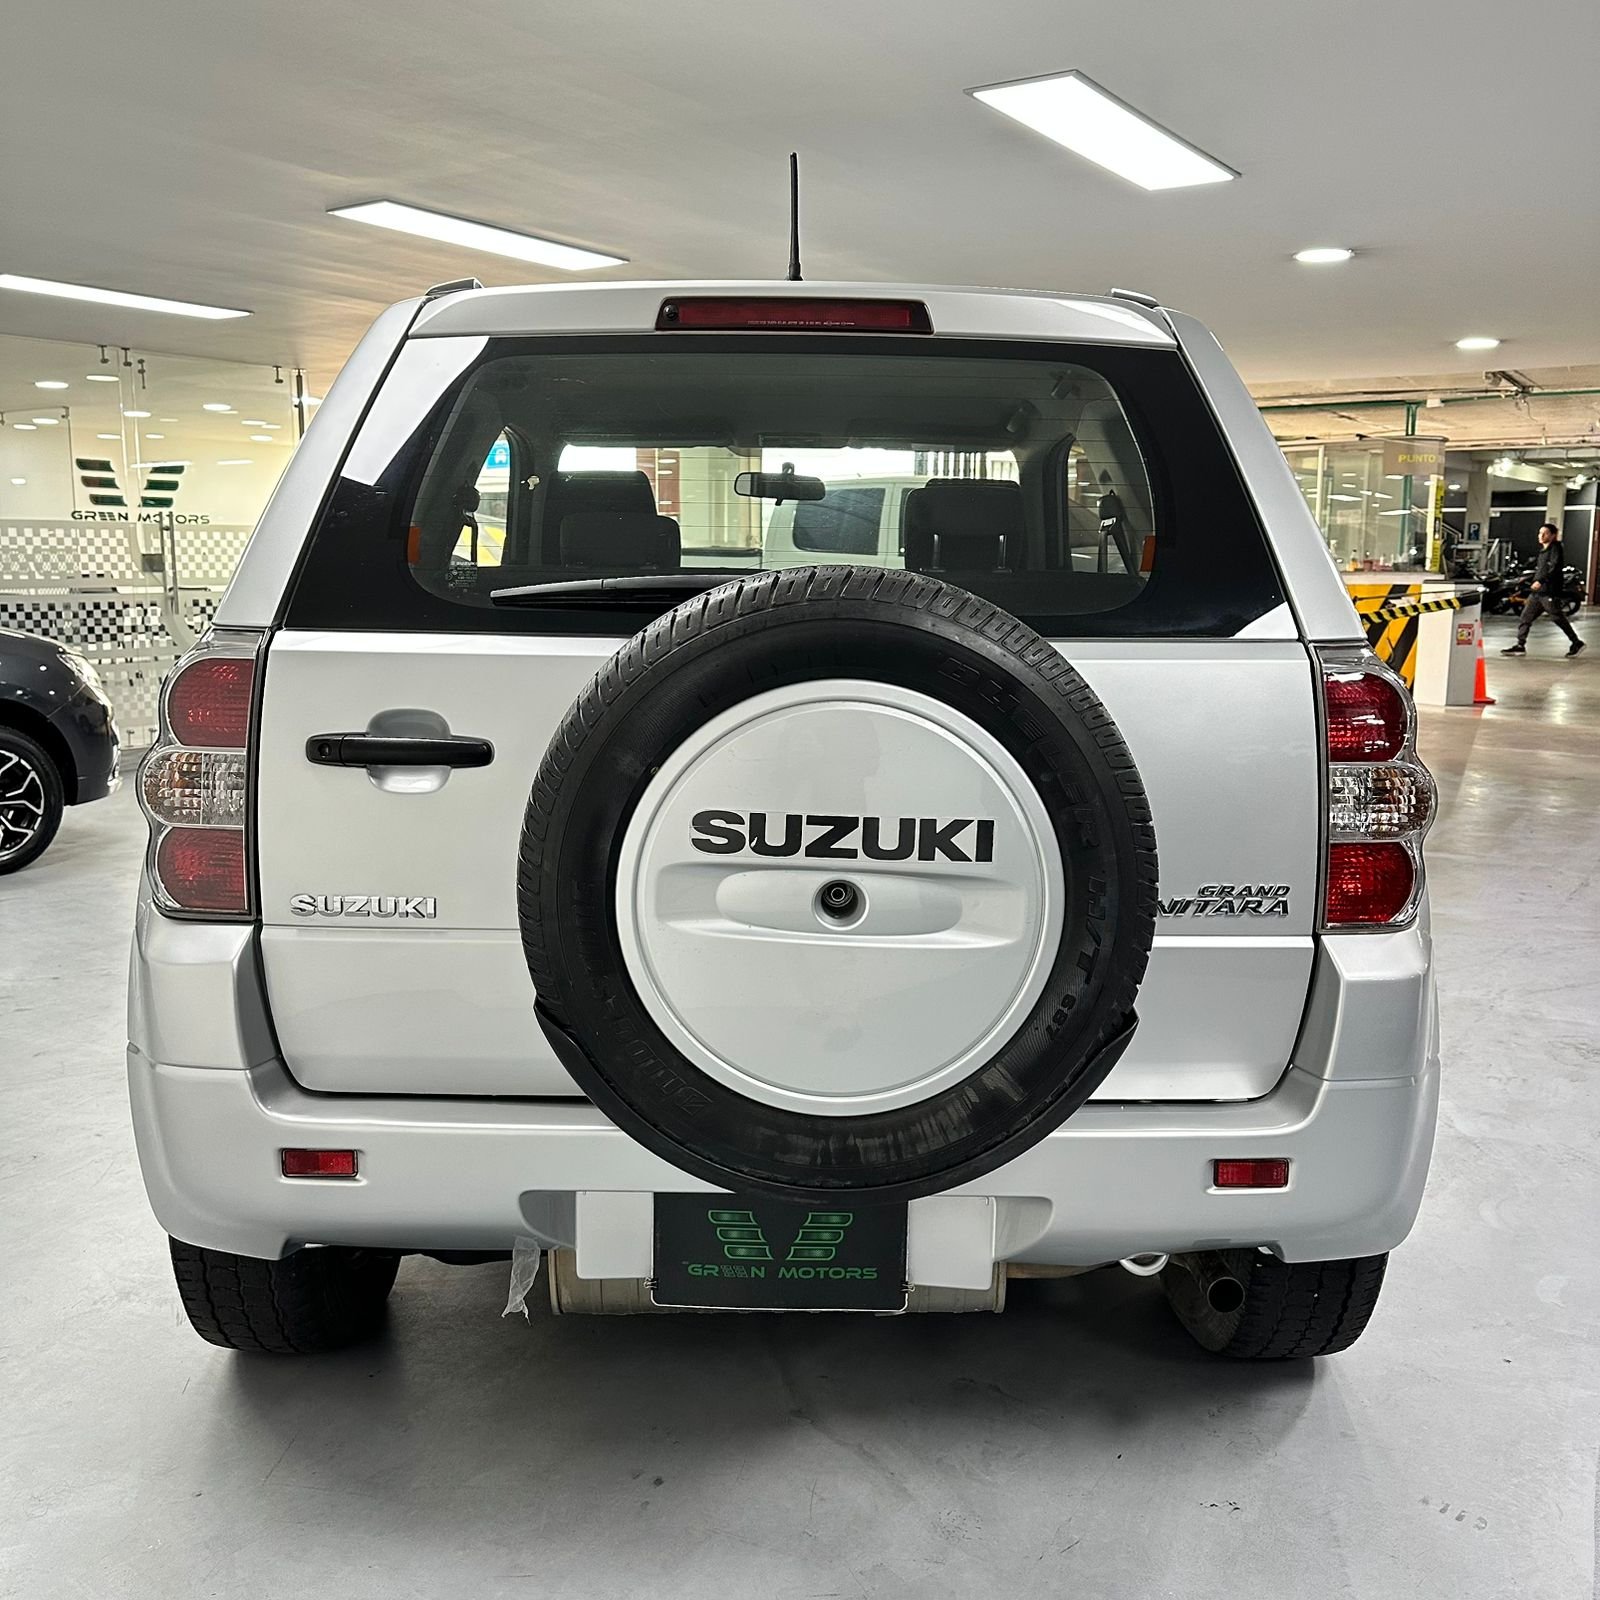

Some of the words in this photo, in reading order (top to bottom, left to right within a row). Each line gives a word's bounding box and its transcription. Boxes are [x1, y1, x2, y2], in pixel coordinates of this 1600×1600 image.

[1398, 454, 1437, 463] PUNTO
[71, 511, 128, 521] GREEN
[691, 810, 994, 862] SUZUKI
[1199, 884, 1291, 897] GRAND
[290, 893, 437, 919] SUZUKI
[1046, 994, 1076, 1040] 687
[778, 1267, 877, 1280] MOTORS
